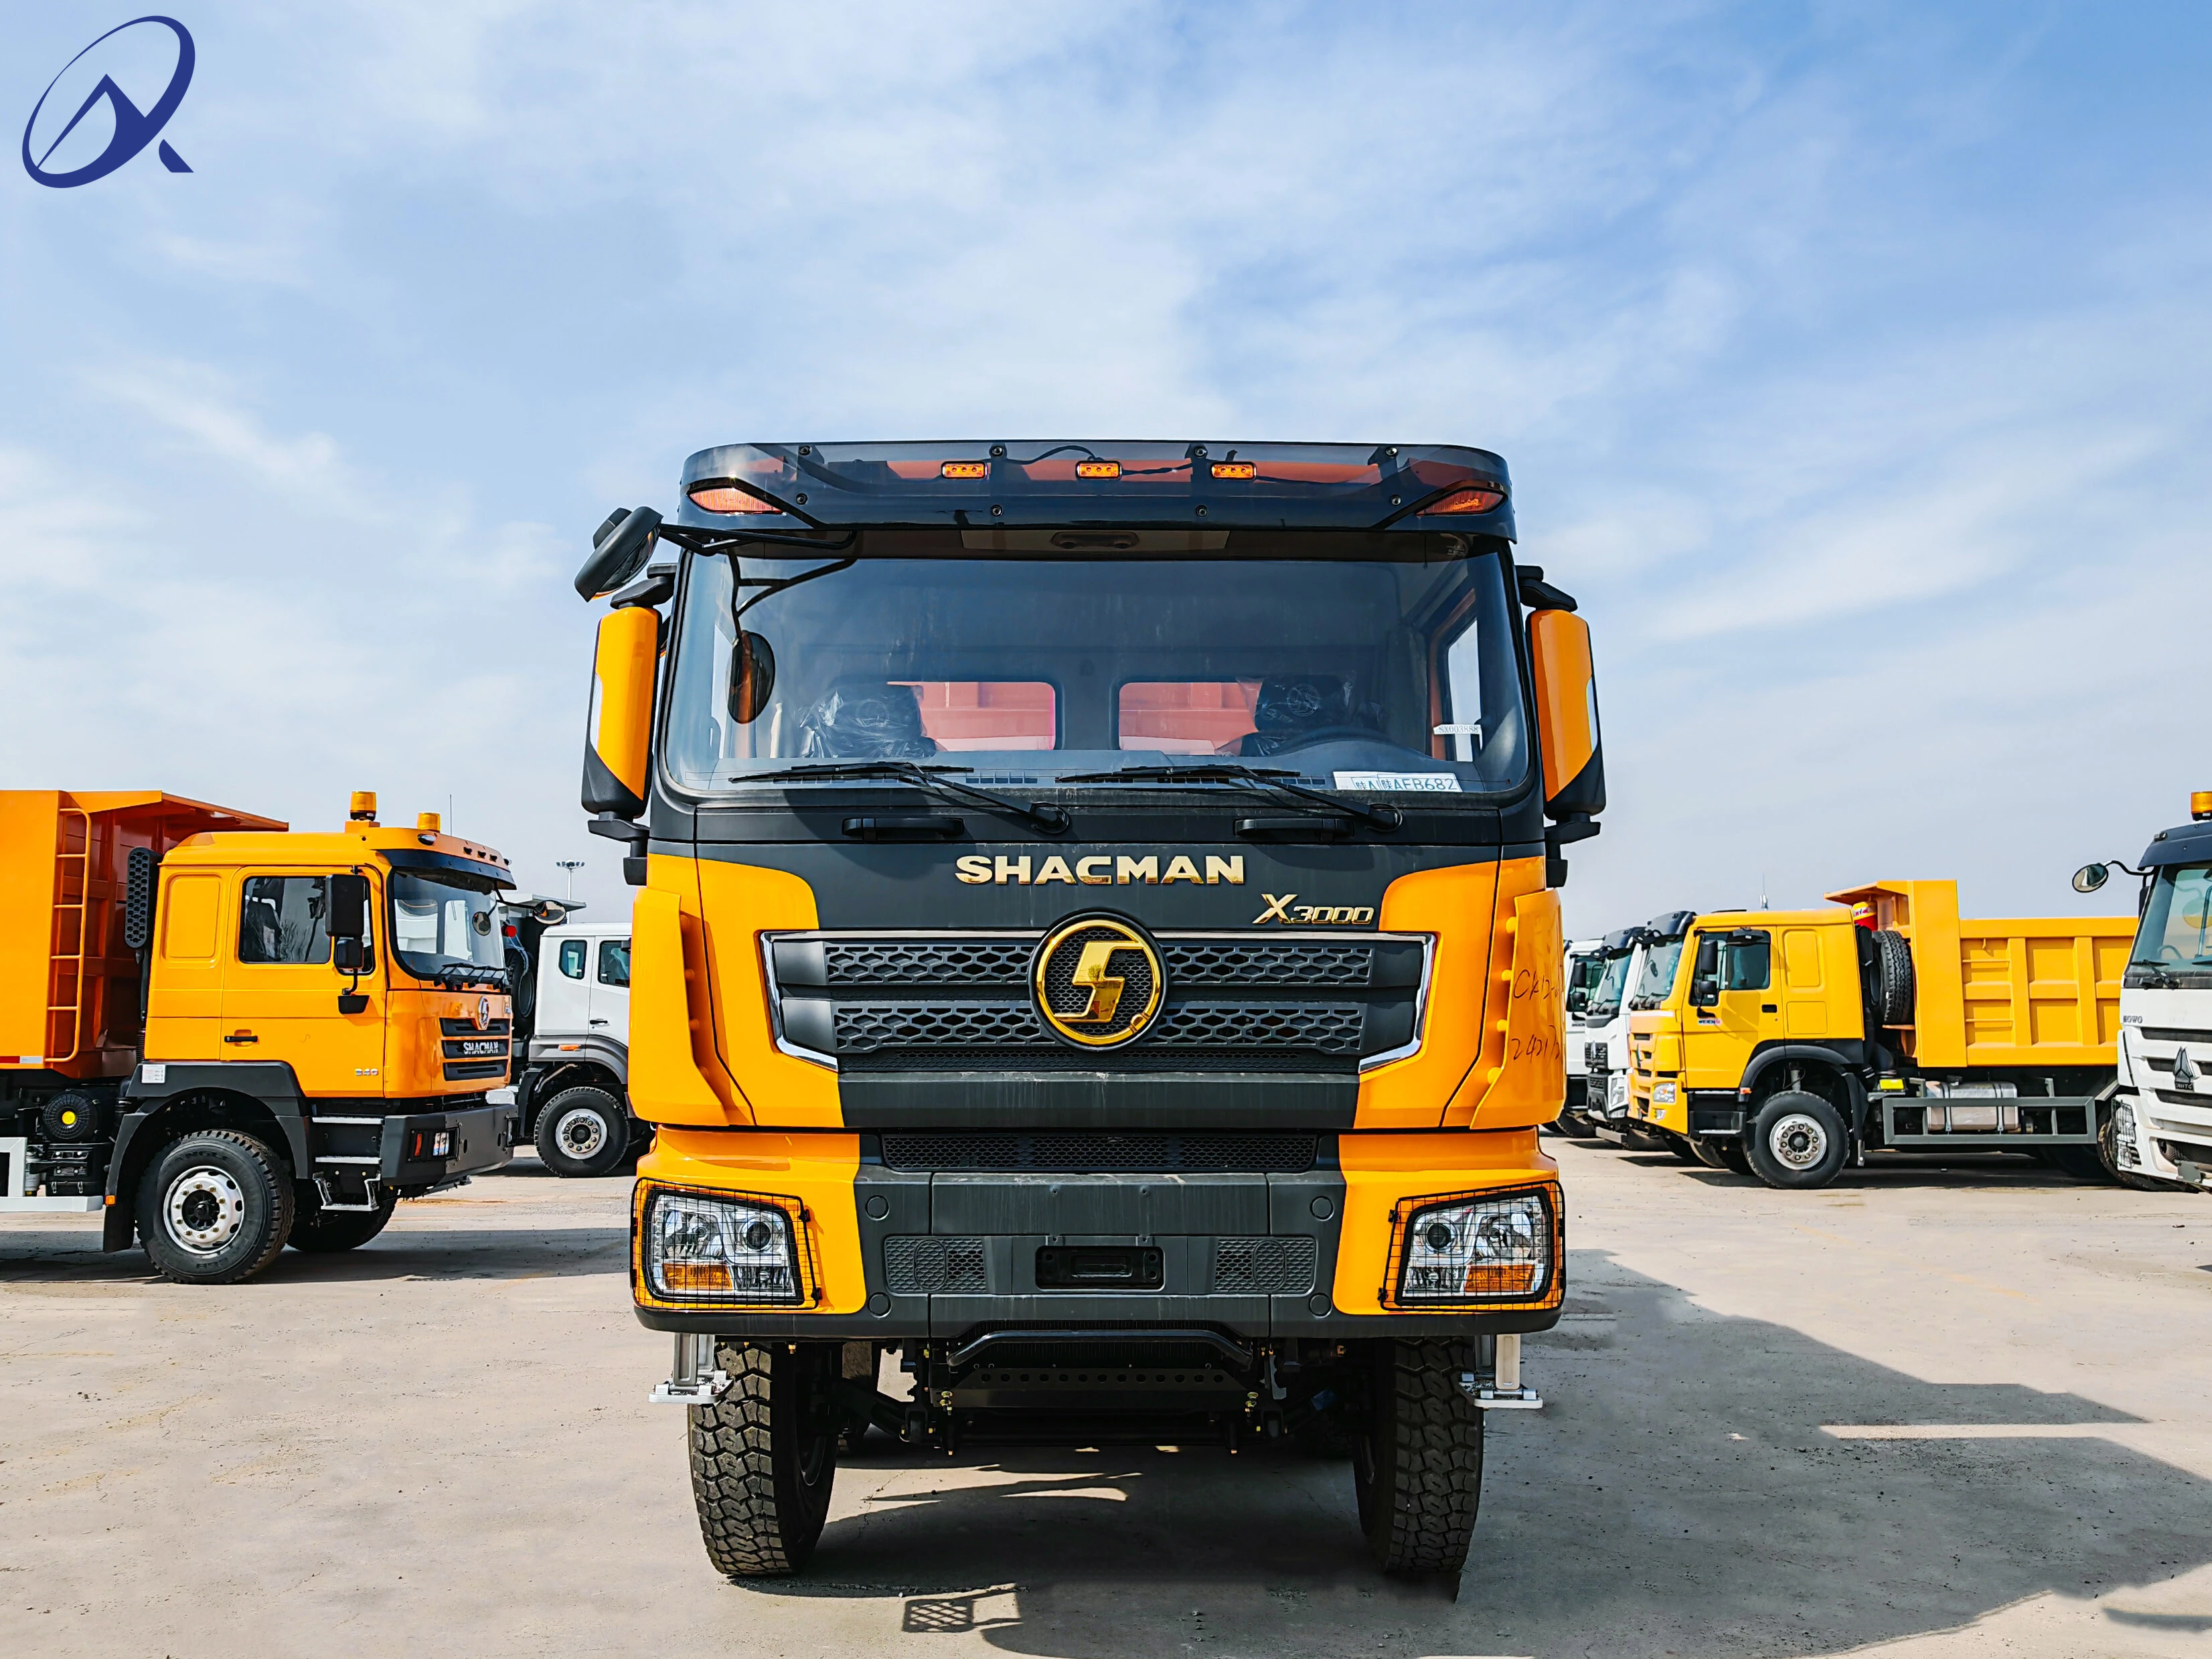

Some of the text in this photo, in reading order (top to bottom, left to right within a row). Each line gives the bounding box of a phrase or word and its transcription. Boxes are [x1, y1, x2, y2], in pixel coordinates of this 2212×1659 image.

[1380, 778, 1458, 791] 陕AEB682
[955, 855, 1245, 885] SHACMAN
[1253, 893, 1374, 925] X3000
[463, 1041, 499, 1055] SHACMAN
